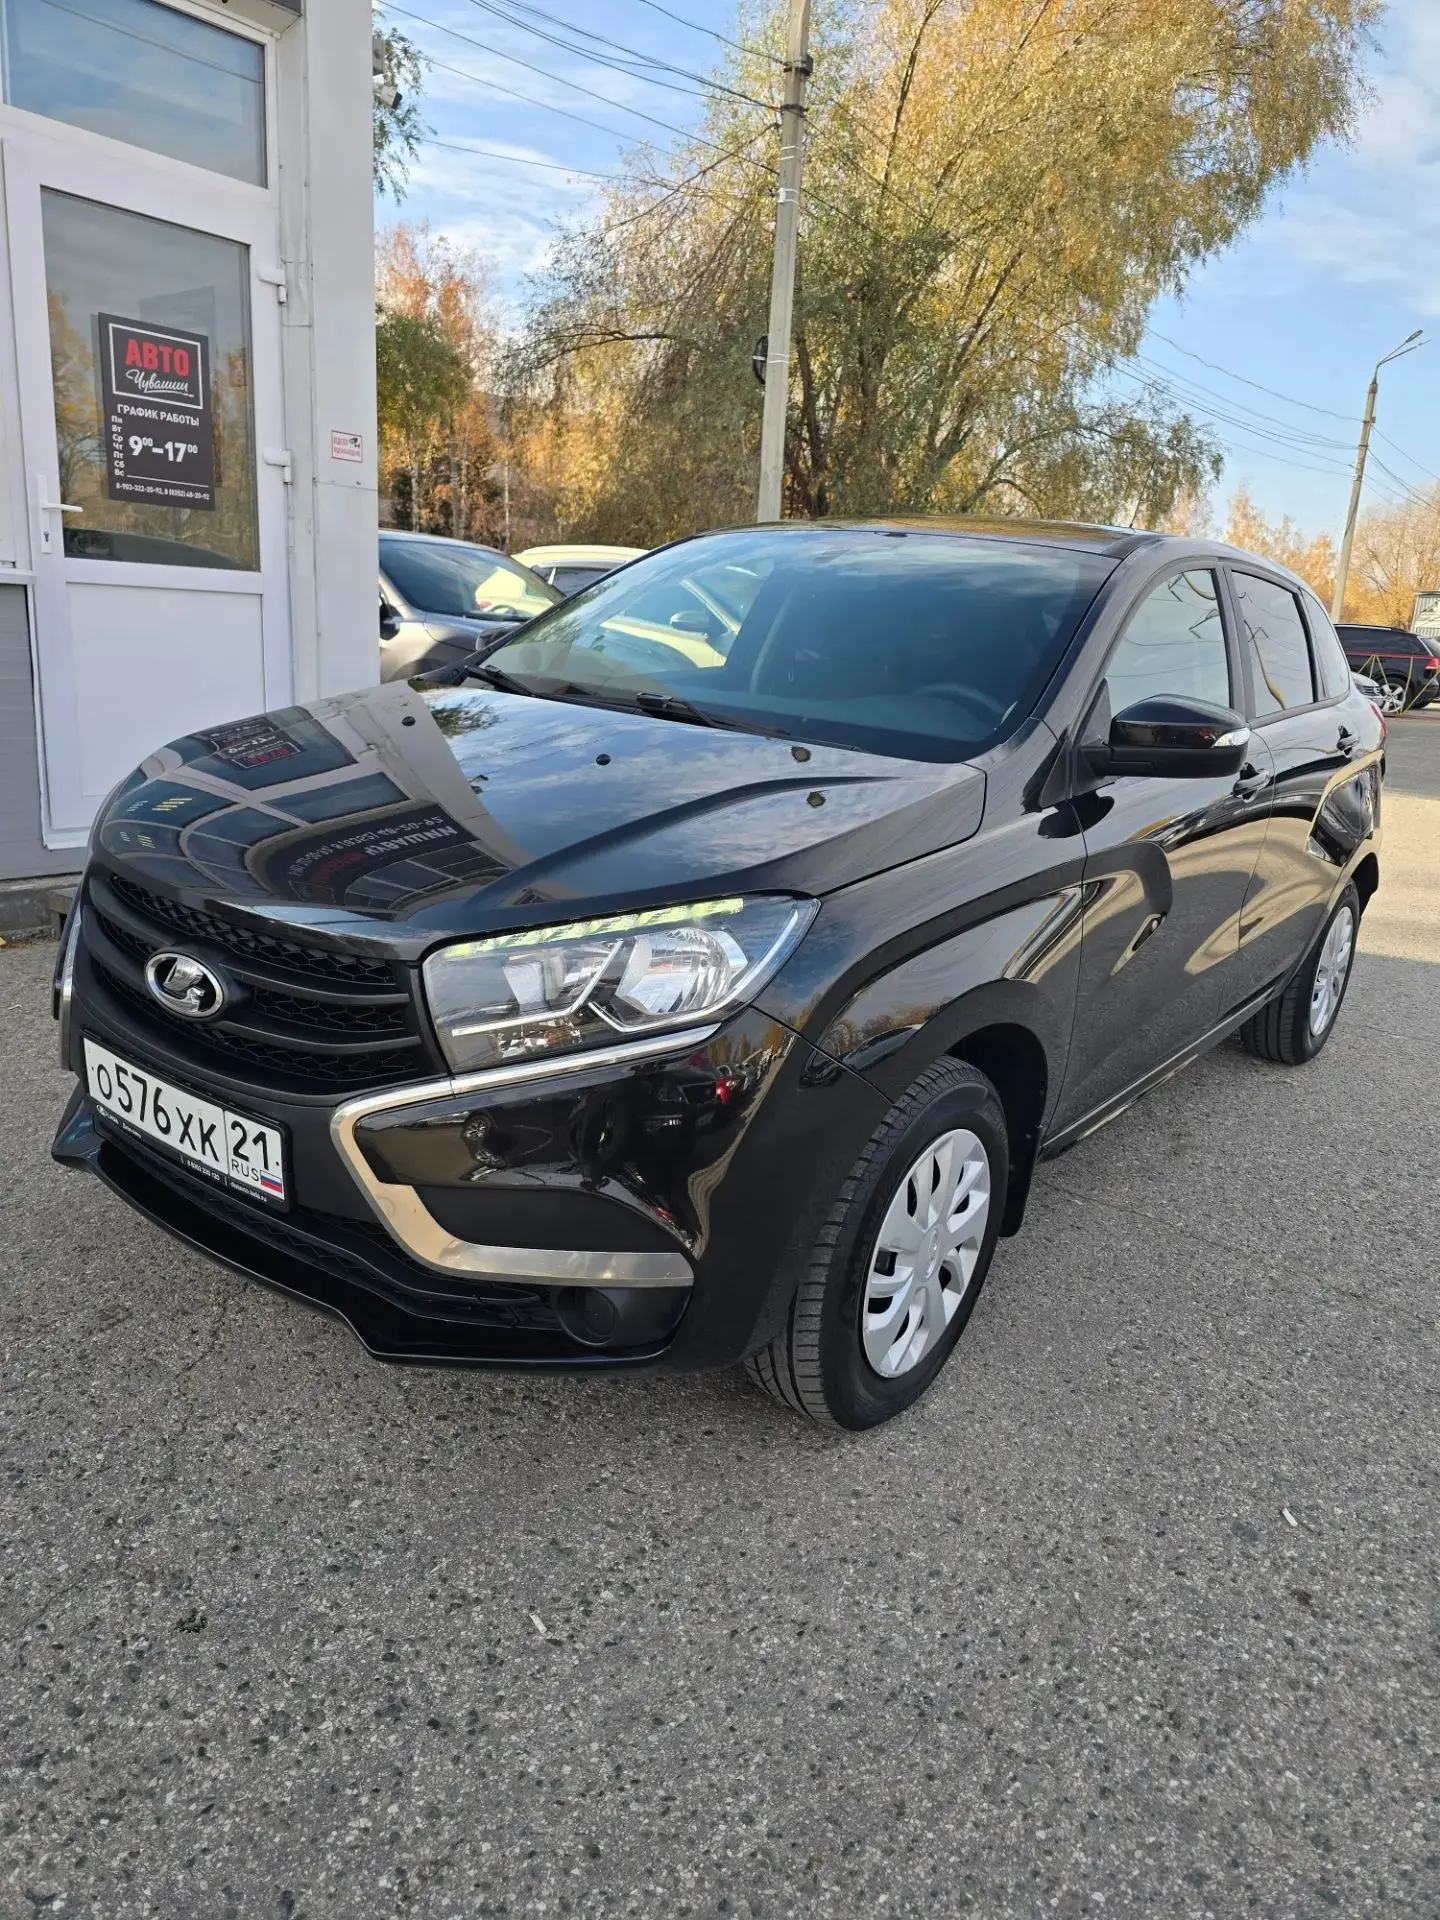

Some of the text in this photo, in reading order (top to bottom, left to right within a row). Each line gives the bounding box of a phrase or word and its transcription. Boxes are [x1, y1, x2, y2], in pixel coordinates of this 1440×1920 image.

[125, 338, 190, 377] АВТО
[125, 368, 194, 398] Чувашии
[111, 415, 123, 424] Пн
[117, 403, 200, 427] ГРАФИК РАБОТЫ
[111, 424, 122, 433] Вт
[112, 433, 124, 443] Ср
[230, 1119, 270, 1171] 21
[231, 1158, 260, 1182] RUS
